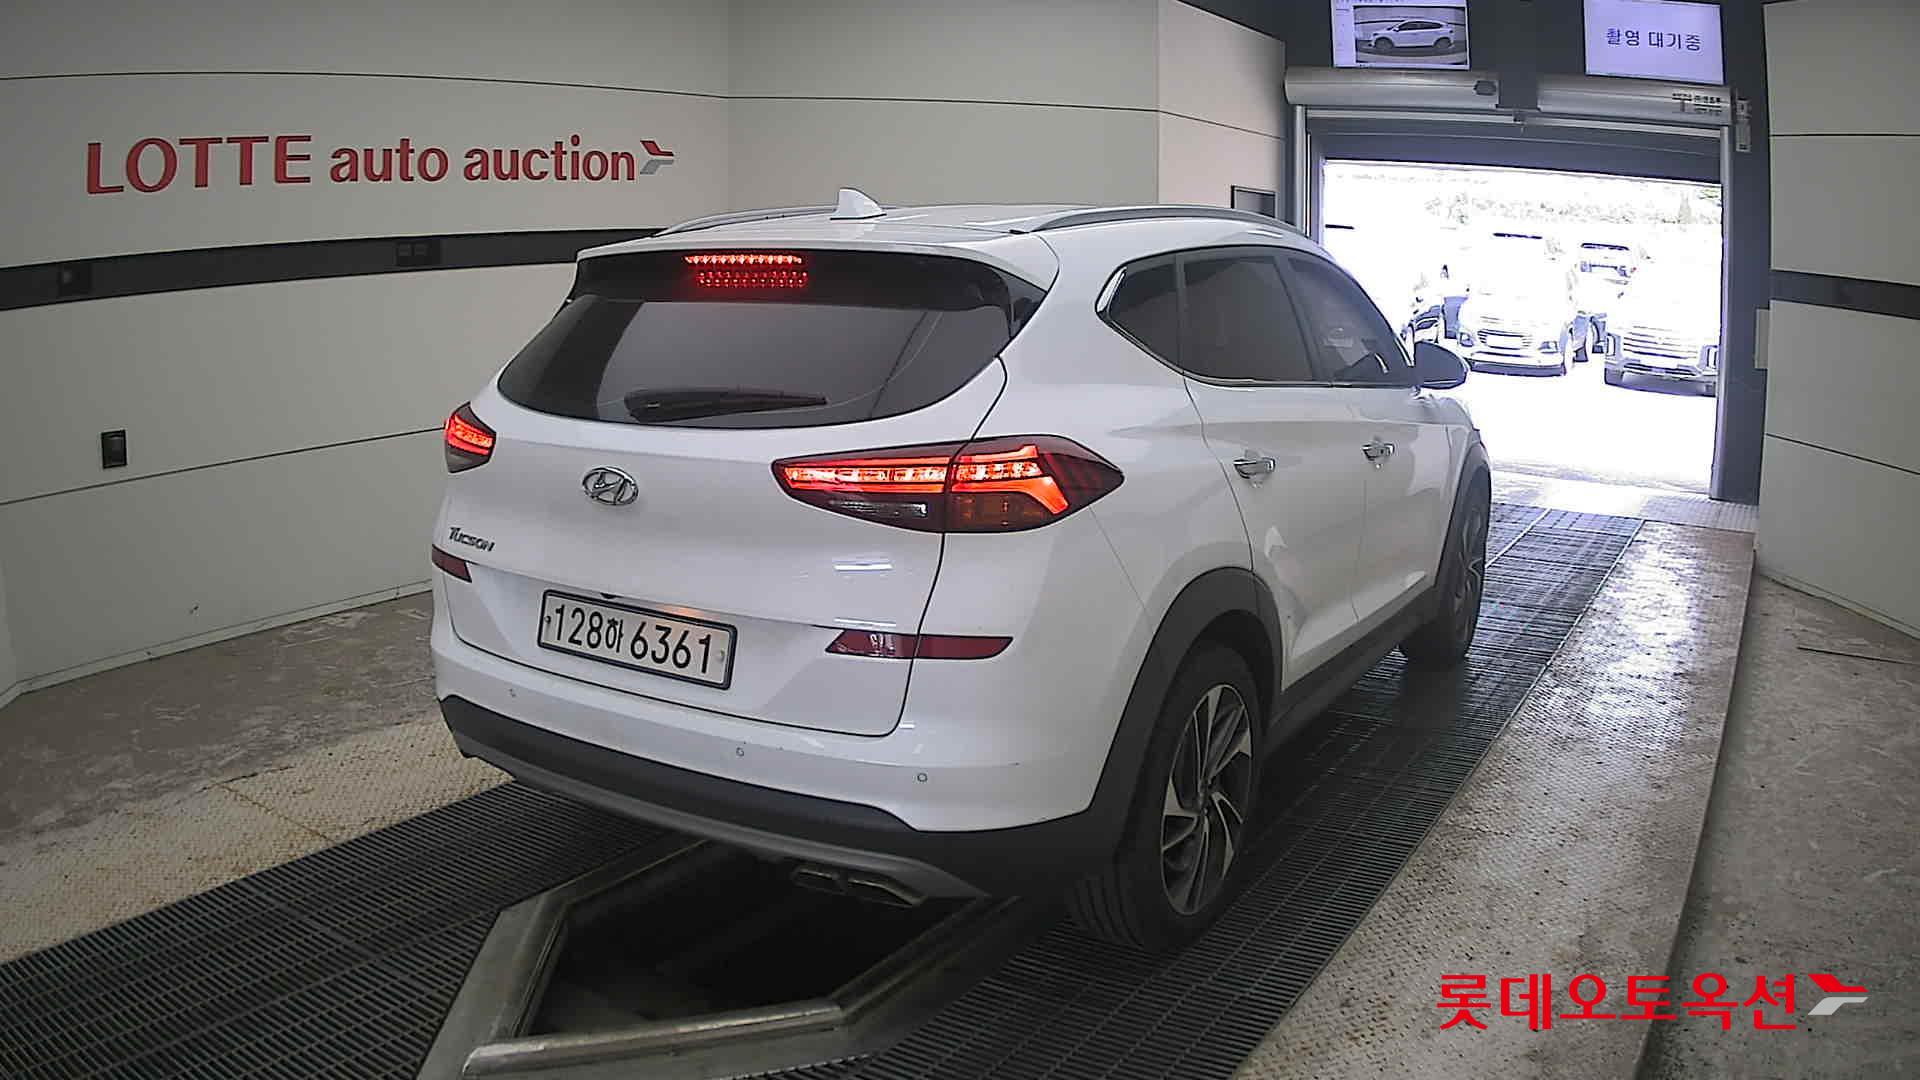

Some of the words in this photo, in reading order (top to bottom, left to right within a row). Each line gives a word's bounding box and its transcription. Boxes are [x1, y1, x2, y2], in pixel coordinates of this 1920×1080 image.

[1606, 28, 1641, 48] 촬영
[1648, 31, 1702, 52] 대기중
[86, 134, 312, 195] LOTTE
[329, 137, 449, 184] auto
[463, 134, 636, 182] auction
